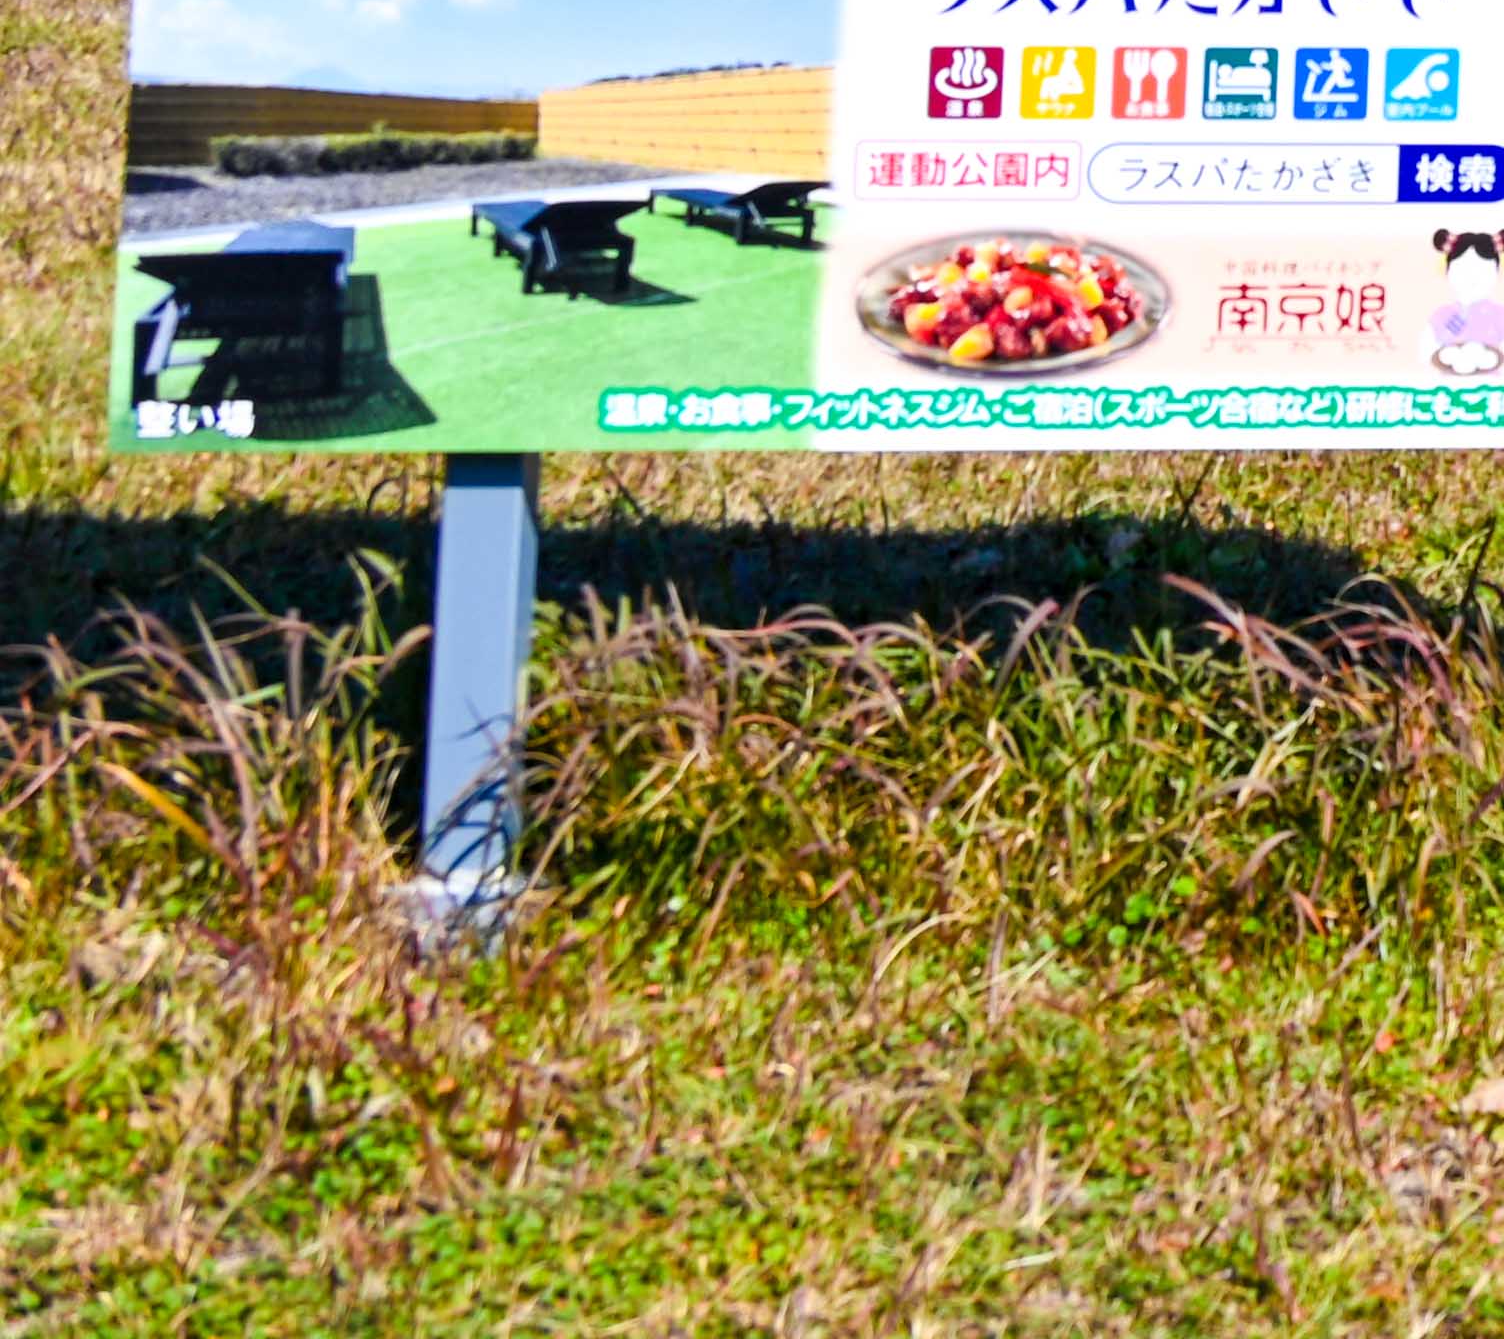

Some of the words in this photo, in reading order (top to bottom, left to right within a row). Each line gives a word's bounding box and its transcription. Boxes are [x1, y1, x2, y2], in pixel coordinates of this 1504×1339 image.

[868, 151, 1070, 189] 運動公園内
[1117, 156, 1376, 193] ラスパたかざき
[1414, 153, 1498, 193] 検索
[1217, 283, 1387, 333] 南京娘
